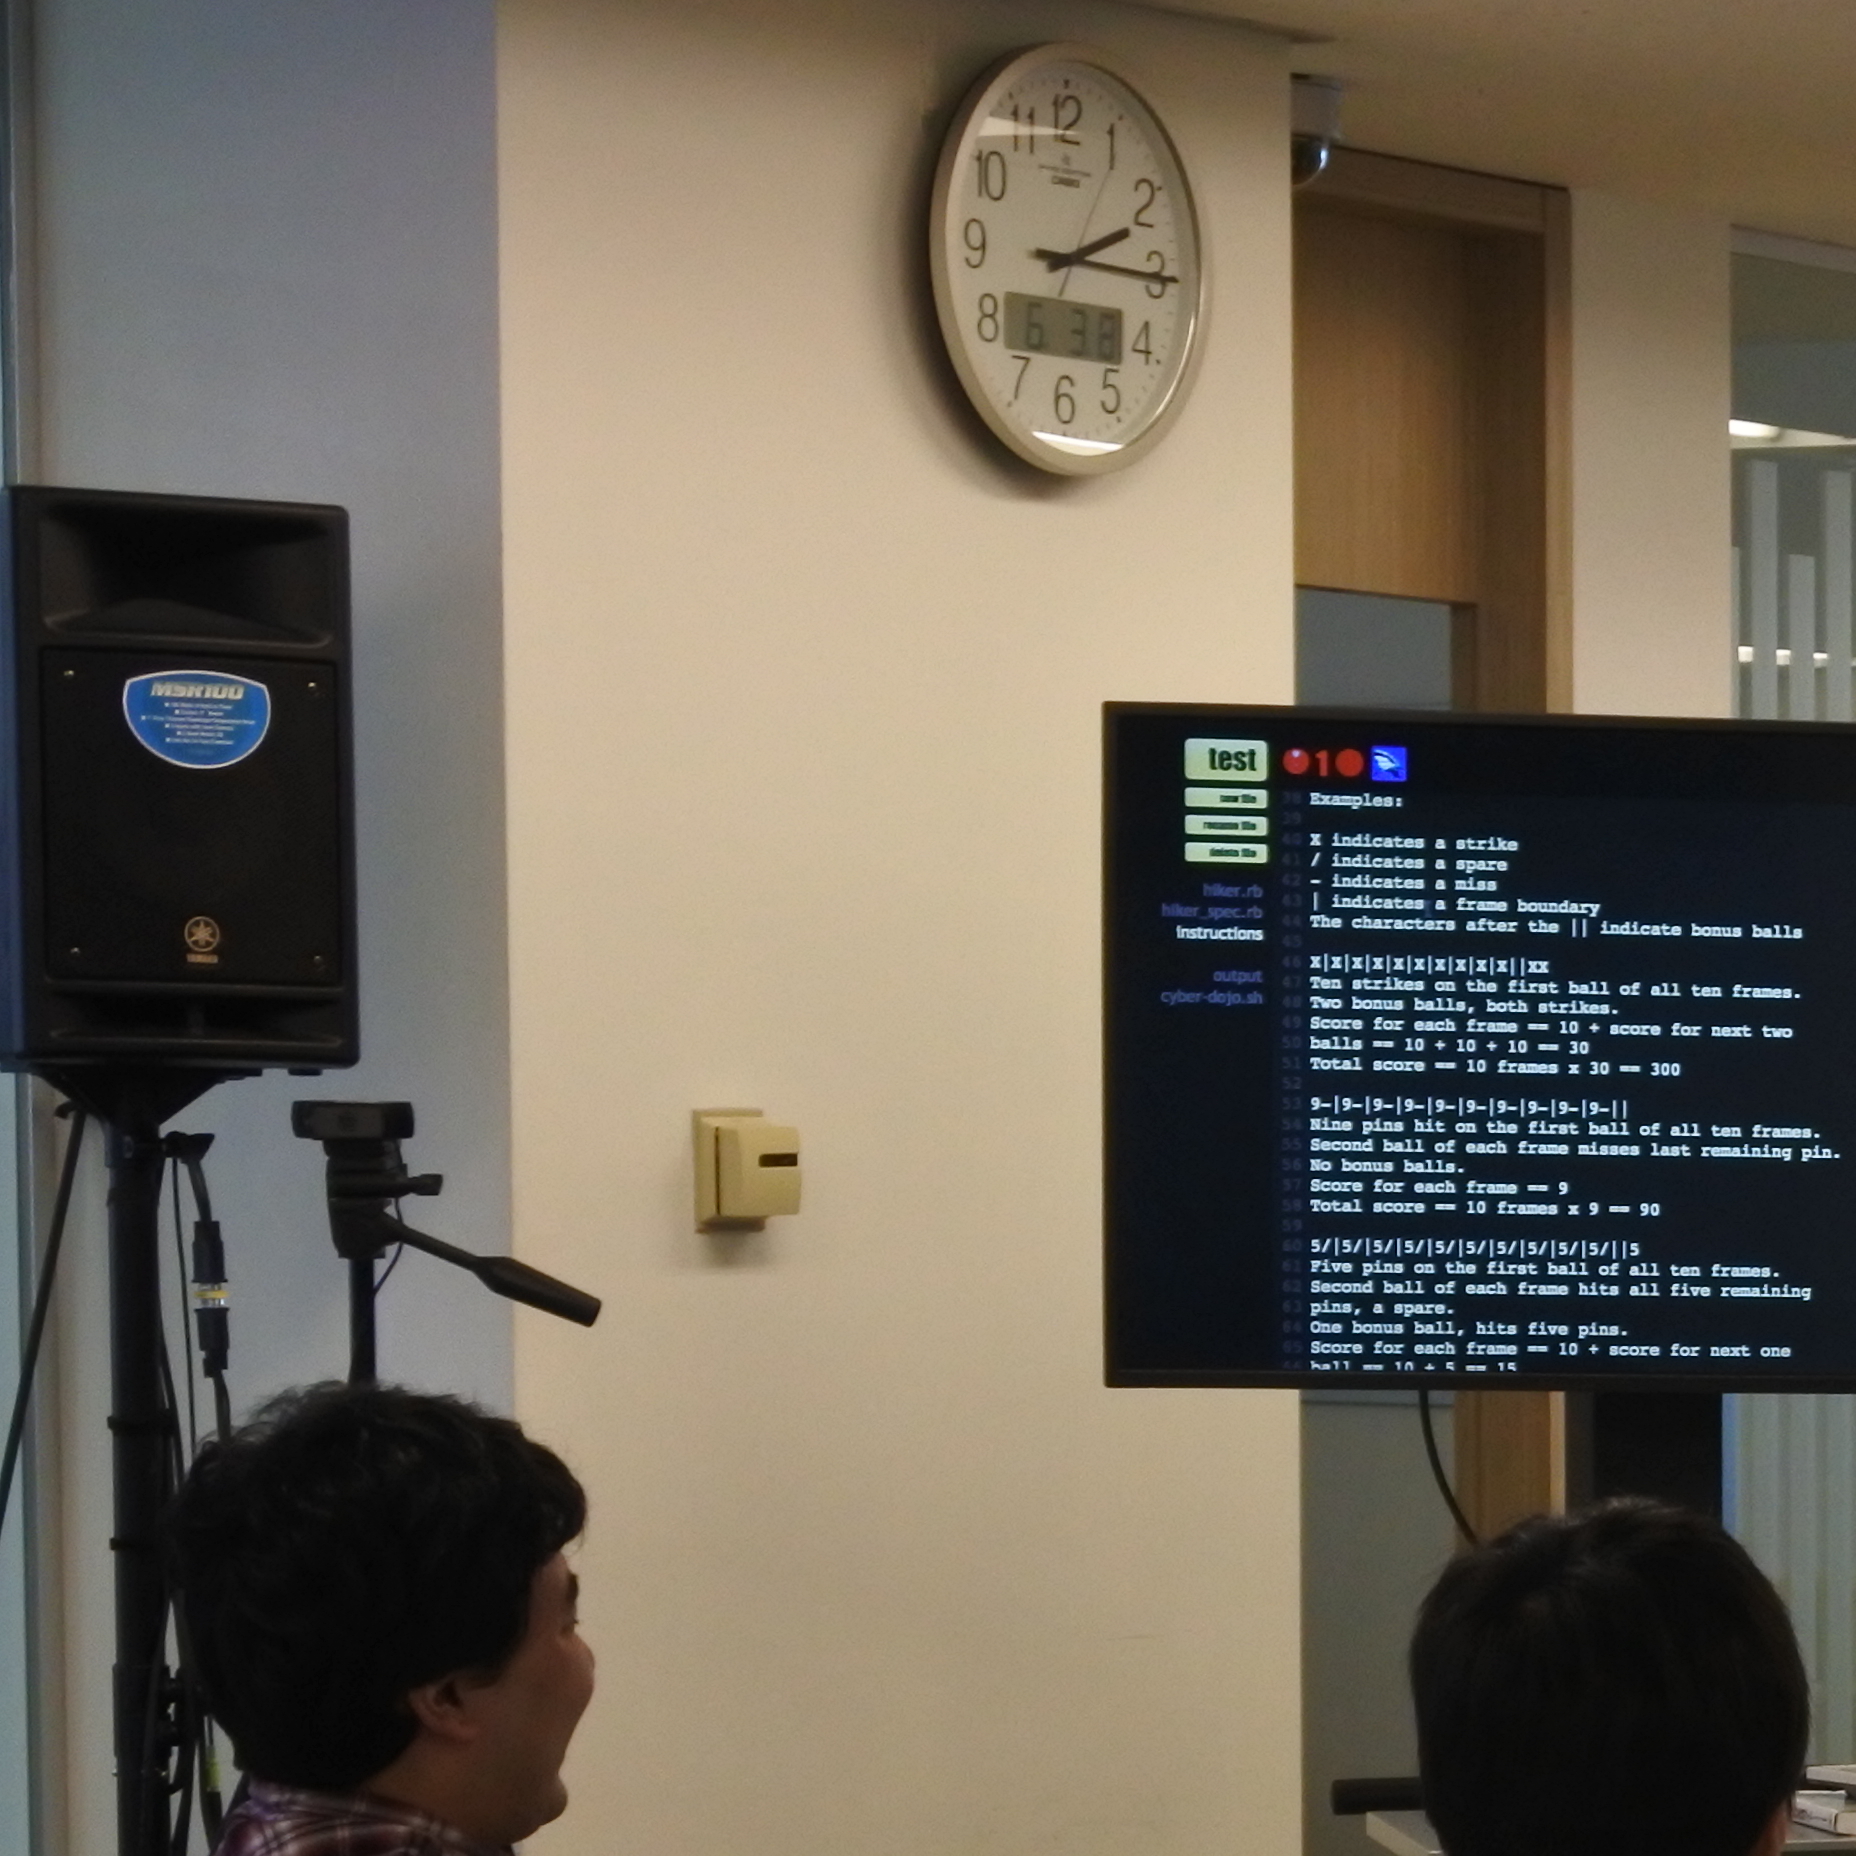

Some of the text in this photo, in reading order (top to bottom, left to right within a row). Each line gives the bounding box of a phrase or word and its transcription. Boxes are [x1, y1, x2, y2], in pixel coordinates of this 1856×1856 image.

[1012, 104, 1035, 155] 11
[1053, 93, 1083, 146] 12
[1107, 123, 1116, 170] 1
[976, 150, 1006, 201] 10
[1134, 177, 1155, 228] 2
[964, 219, 986, 268] 9
[1144, 251, 1167, 299] 3
[978, 294, 998, 342] 8
[1132, 321, 1152, 365] 4
[1011, 355, 1030, 401] 7
[1055, 375, 1076, 424] 6
[1101, 369, 1120, 414] 5
[1208, 748, 1257, 771] test
[1315, 750, 1329, 777] 1
[1309, 792, 1403, 810] Examples:
[1309, 832, 1519, 852] X indicates a strike
[1330, 852, 1509, 875] indicates a spare
[1203, 883, 1264, 898] hiker.rb
[1330, 872, 1498, 892] indicates a miss
[1330, 893, 1601, 918] indicates a frame boundary
[1176, 925, 1264, 941] instructions
[1309, 913, 1804, 940] The characters after the indicate bonus balls
[1213, 970, 1264, 984] output
[1309, 975, 1801, 999] Ten strikes on the first ball of all ten frames.
[1160, 990, 1264, 1006] cyber-dojo.sh
[1309, 995, 1619, 1016] Two bonus balls, both strikes.
[1309, 1015, 1794, 1039] Score for each frame 10 score for next two
[1309, 1035, 1591, 1055] balls 10 10 10 30
[1309, 1056, 1682, 1077] Total score 10 frames 30 300
[1309, 1116, 1821, 1139] Nine pins hit on the first ball of all ten frames.
[1309, 1137, 1841, 1163] Second ball of each frame misses last remaining pin.
[1309, 1157, 1465, 1174] No bonus balls.
[1309, 1178, 1569, 1196] Score for each frame 9
[1309, 1198, 1661, 1217] Total score 10 frames 9 90
[1309, 1258, 1780, 1278] Five pins on the first ball of all ten frames.
[1310, 1279, 1812, 1302] Second ball of each frame hits all five remaining
[1309, 1299, 1455, 1318] pins, spare.
[1309, 1319, 1628, 1340] One bonus ball, hits five pins.
[1310, 1340, 1792, 1358] Score for each frame 10 score for next one
